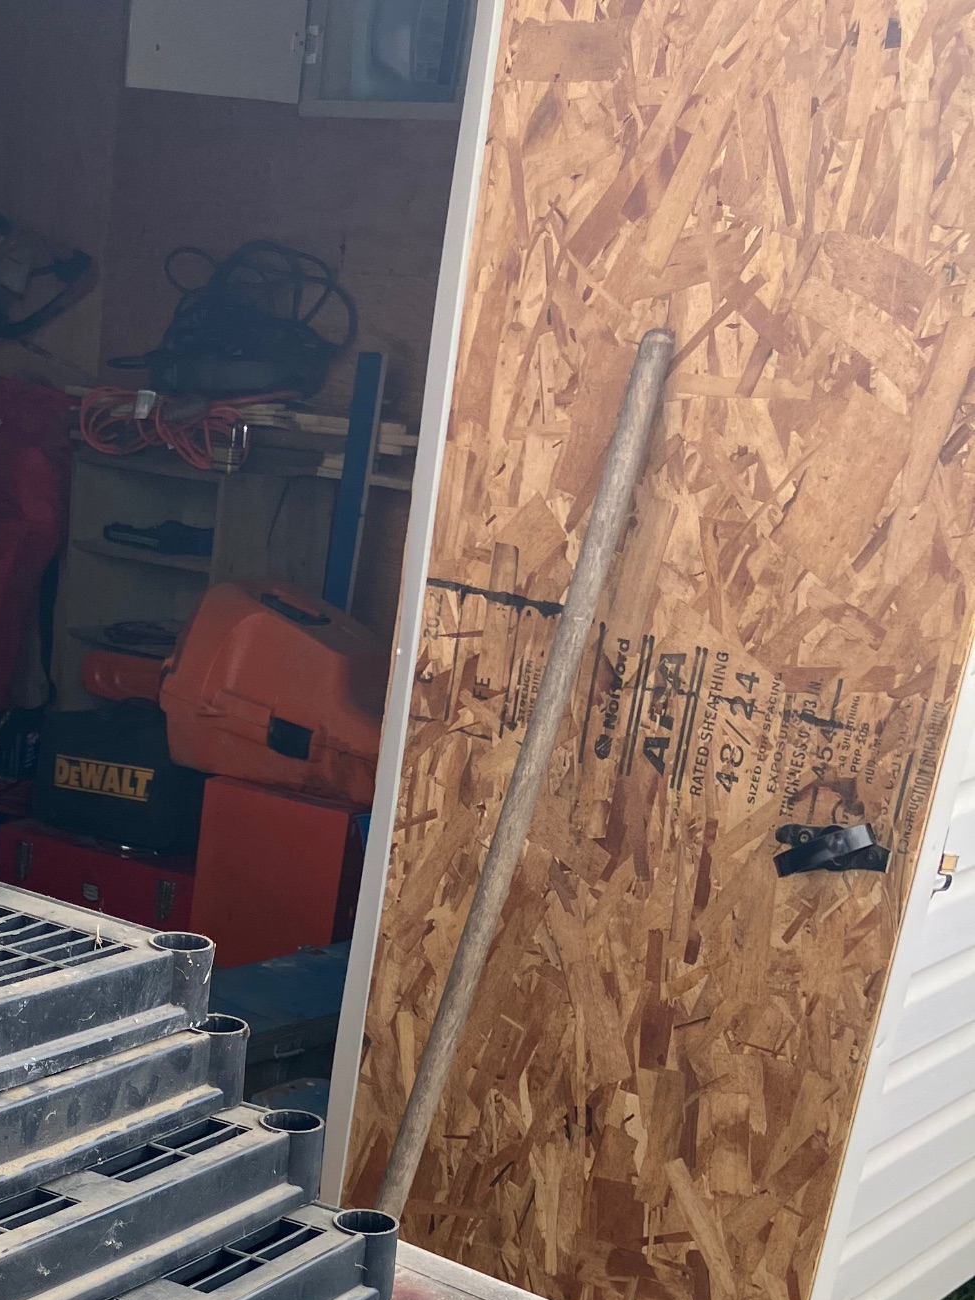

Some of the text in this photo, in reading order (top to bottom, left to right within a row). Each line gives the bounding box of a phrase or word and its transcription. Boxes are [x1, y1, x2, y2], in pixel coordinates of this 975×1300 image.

[518, 660, 533, 722] STRENGTH
[690, 652, 730, 796] RATED SHEATHING
[716, 671, 760, 794] 48/24
[798, 699, 818, 740] 0.03
[55, 757, 154, 798] DEWALT
[747, 765, 762, 805] SIZED
[763, 672, 783, 732] SPACING
